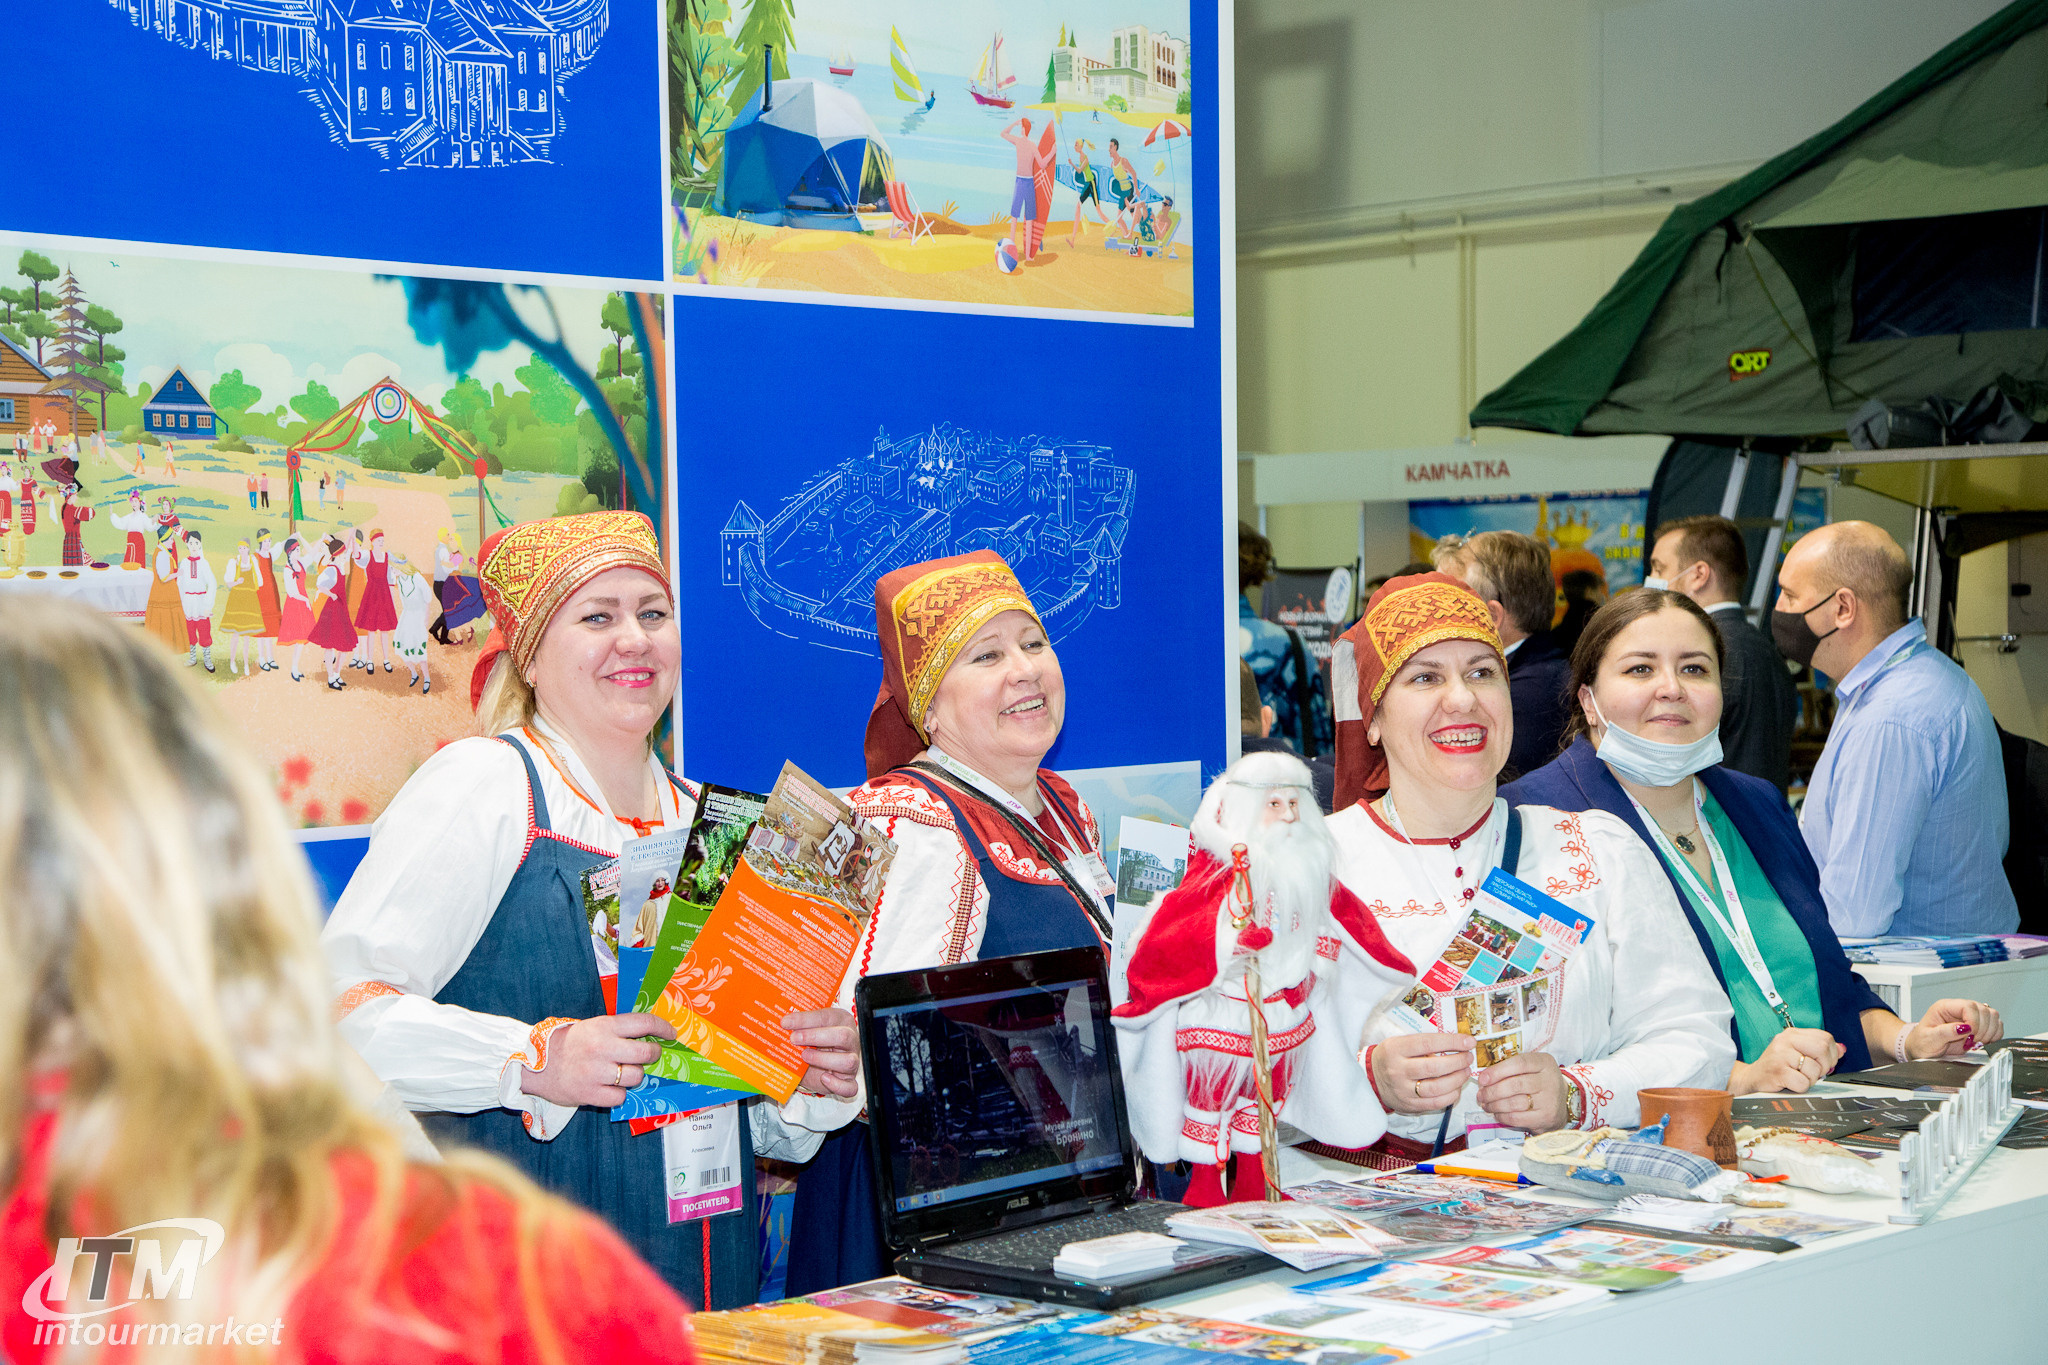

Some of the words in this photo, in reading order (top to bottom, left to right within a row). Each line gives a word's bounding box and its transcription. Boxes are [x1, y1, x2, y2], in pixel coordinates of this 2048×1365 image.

[1730, 351, 1770, 373] ORT
[1406, 460, 1510, 482] КАМЧАТКА
[692, 1123, 712, 1132] Ольга
[1066, 1118, 1093, 1130] деревни
[1056, 1131, 1094, 1147] Бронино
[682, 1195, 730, 1214] ПОСЕТИТЕЛЬ
[1007, 1196, 1029, 1210] ASUS
